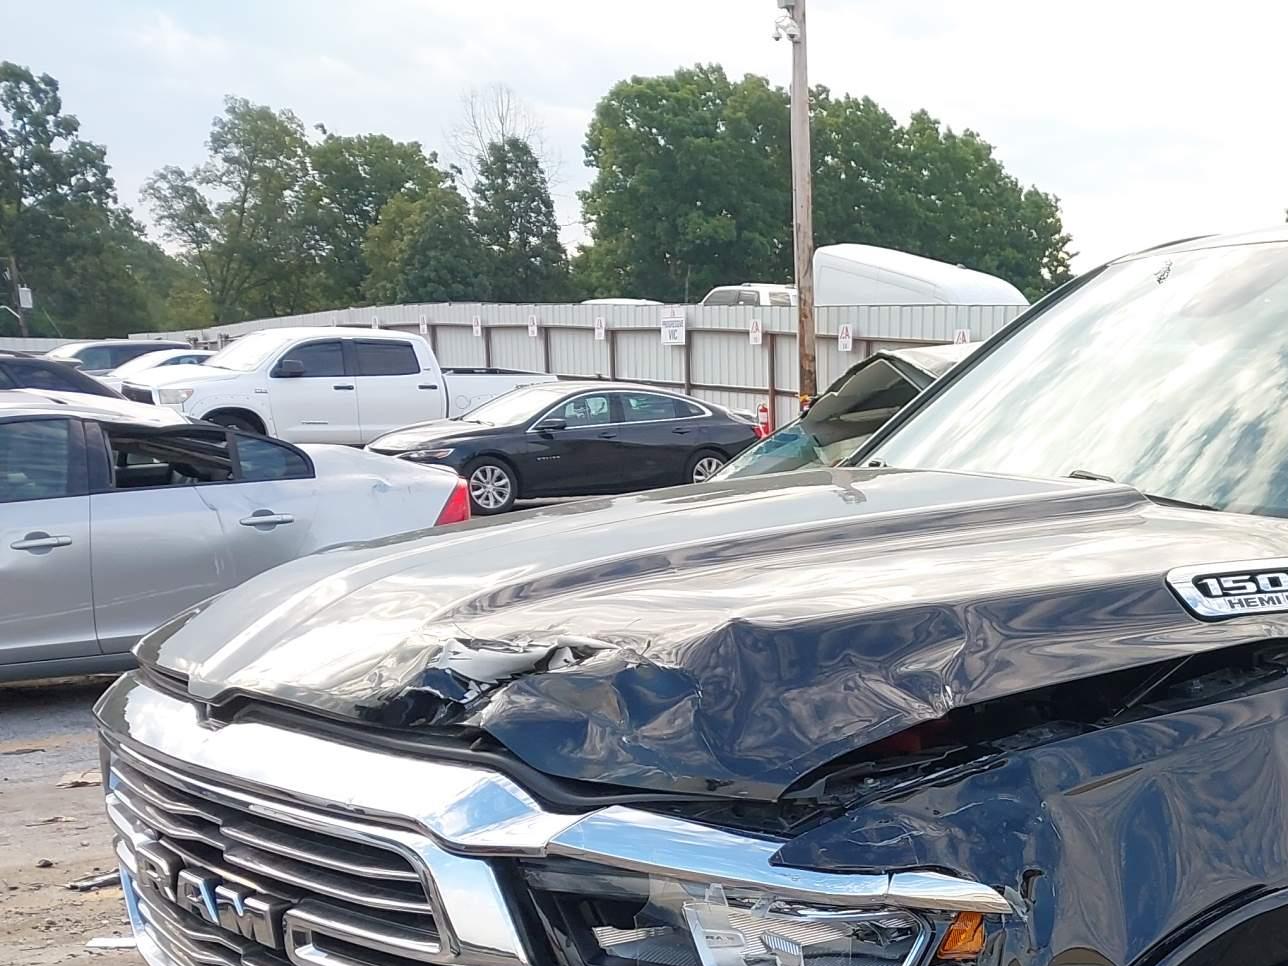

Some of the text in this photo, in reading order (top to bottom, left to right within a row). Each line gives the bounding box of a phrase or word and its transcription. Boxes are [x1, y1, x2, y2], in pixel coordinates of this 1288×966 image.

[668, 329, 678, 341] VIC
[1227, 594, 1282, 609] HEMI
[135, 841, 290, 950] RAM
